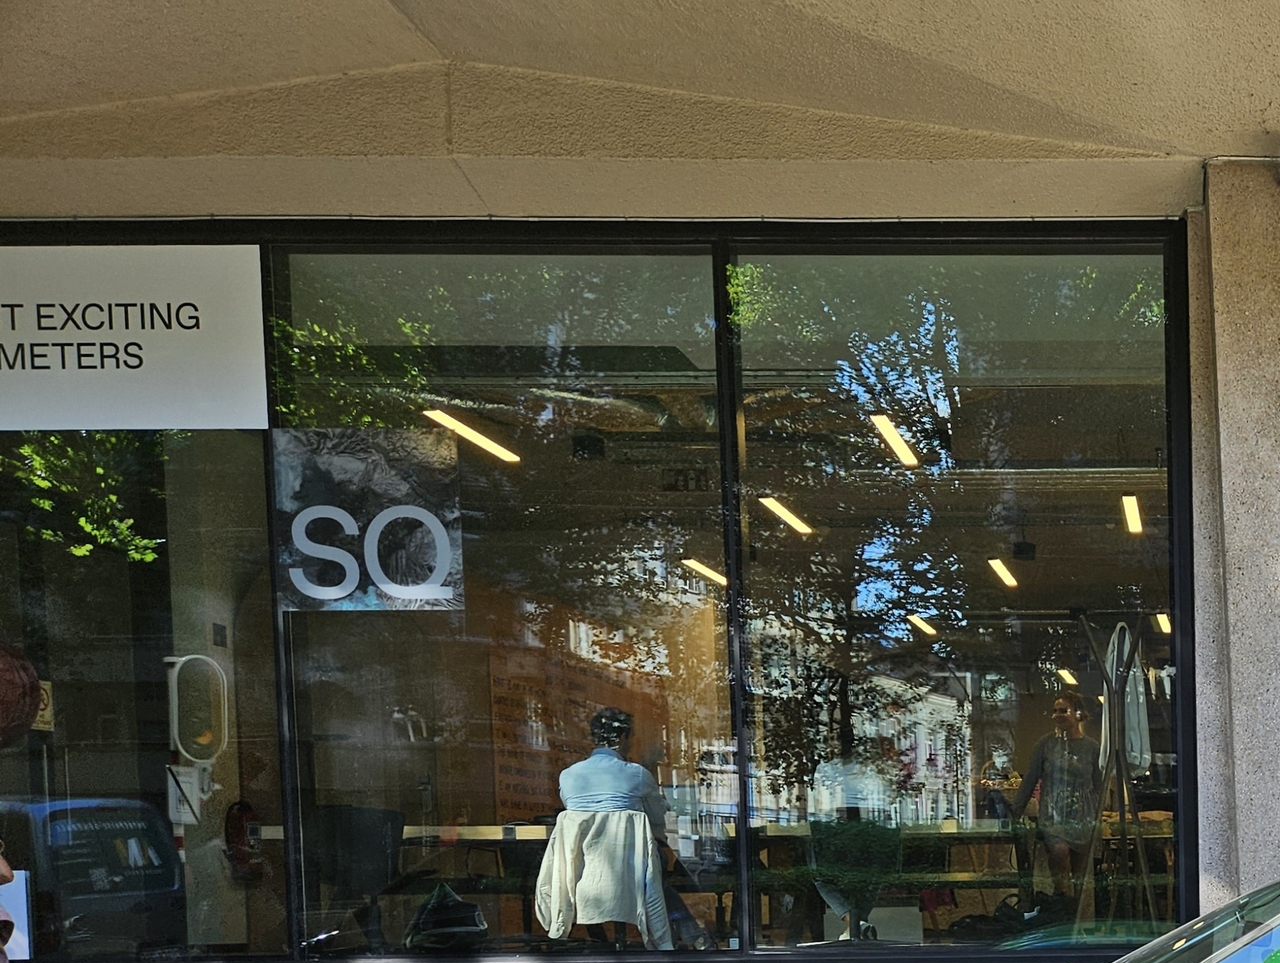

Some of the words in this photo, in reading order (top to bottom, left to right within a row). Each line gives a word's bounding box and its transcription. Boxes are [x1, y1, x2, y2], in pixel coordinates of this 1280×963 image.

[36, 302, 201, 331] EXCITING
[0, 341, 144, 370] METERS
[289, 505, 454, 600] SQ
